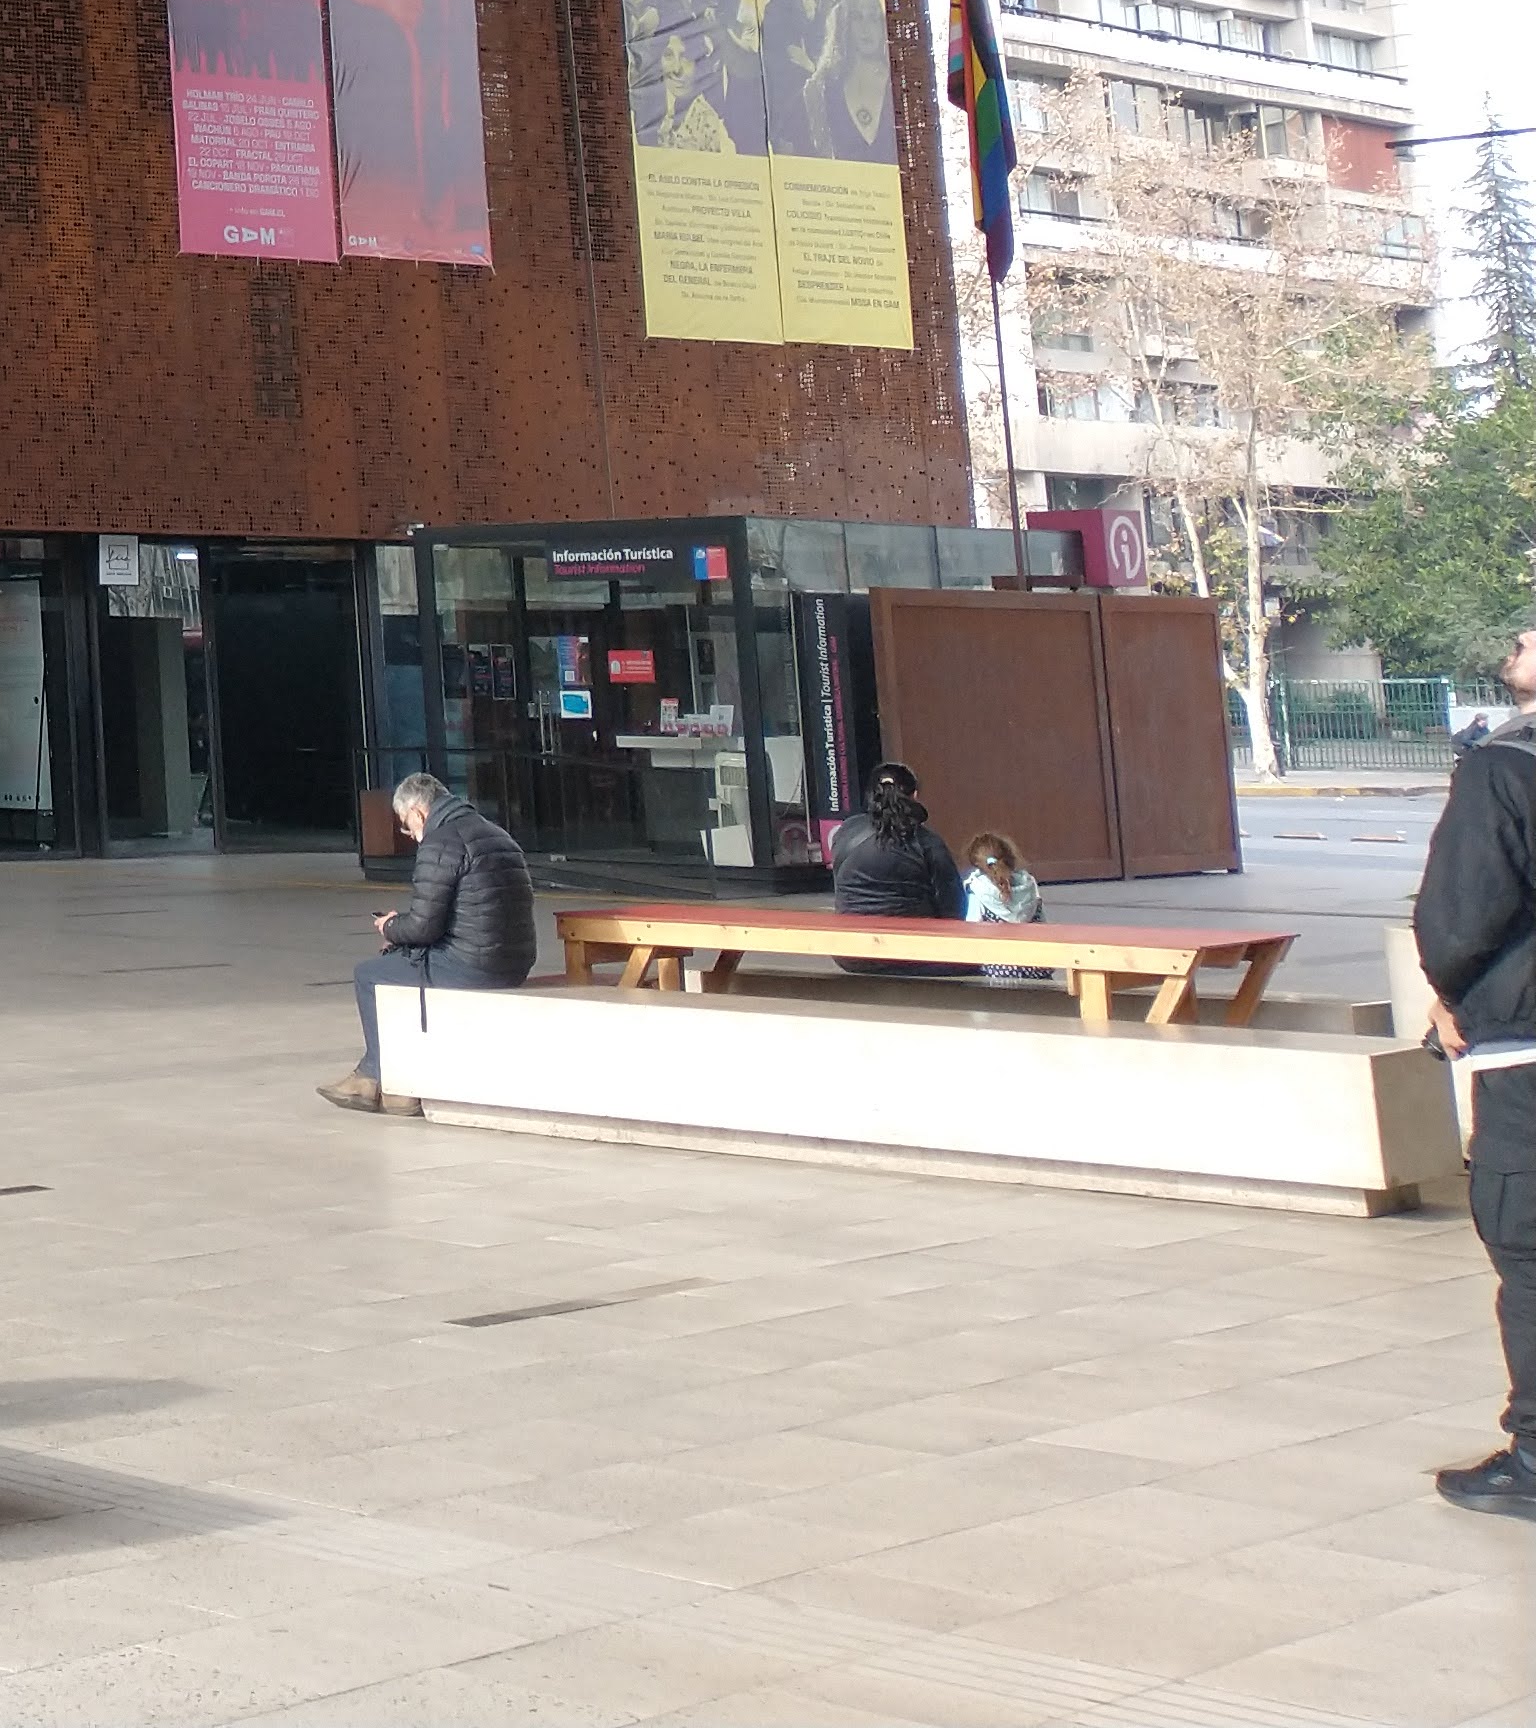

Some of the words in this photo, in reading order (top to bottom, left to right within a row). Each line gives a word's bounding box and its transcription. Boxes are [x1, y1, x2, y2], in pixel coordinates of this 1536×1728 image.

[223, 225, 275, 246] GAM
[553, 548, 622, 563] Información
[623, 547, 674, 561] Turística
[554, 563, 585, 575] Tourist
[587, 563, 645, 575] Information
[815, 598, 828, 660] Information
[820, 662, 831, 697] Tourist
[822, 704, 835, 748] Turística
[826, 749, 840, 812] Información
